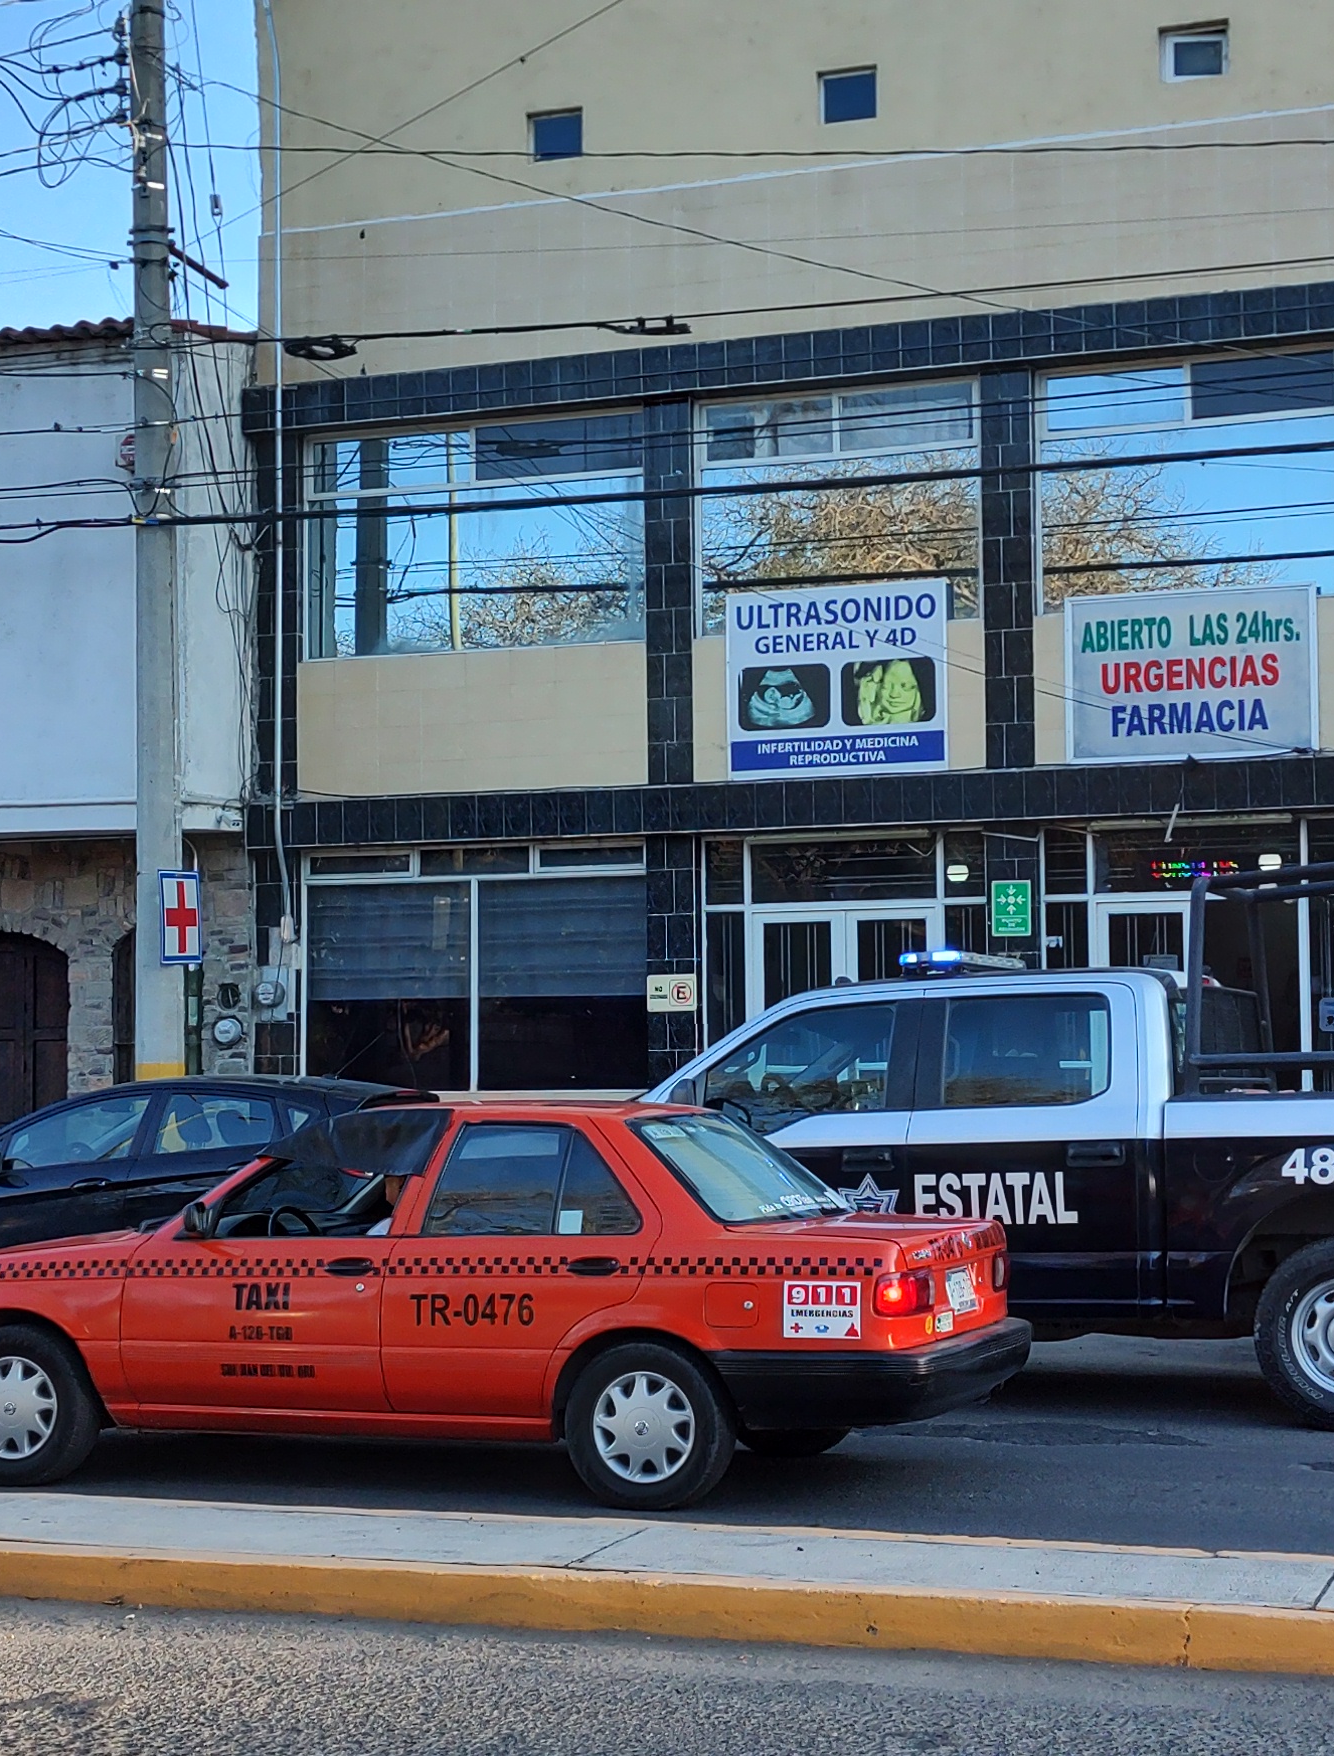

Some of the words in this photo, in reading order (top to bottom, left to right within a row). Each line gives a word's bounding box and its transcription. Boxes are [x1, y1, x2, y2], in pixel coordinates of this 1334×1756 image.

[736, 593, 937, 631] ULTRASONIDO
[754, 631, 860, 655] GENERAL
[865, 629, 880, 649] Y
[883, 626, 917, 648] 4D
[1081, 615, 1172, 654] ABIERTO
[1189, 612, 1228, 647] LAS
[1235, 610, 1301, 645] 24hrs.
[1100, 653, 1280, 695] URGENCIAS
[1111, 698, 1269, 738] FARMACIA
[757, 739, 843, 755] INFERTILIDAD
[845, 739, 855, 751] Y
[855, 735, 919, 750] MEDICINA
[789, 751, 886, 766] REPRODUCTIVA
[913, 1171, 1079, 1225] ESTATAL
[232, 1281, 291, 1311] TAXI
[410, 1293, 534, 1326] TR-0476
[790, 1286, 851, 1304] 911
[790, 1309, 854, 1318] EMERGENCIAS
